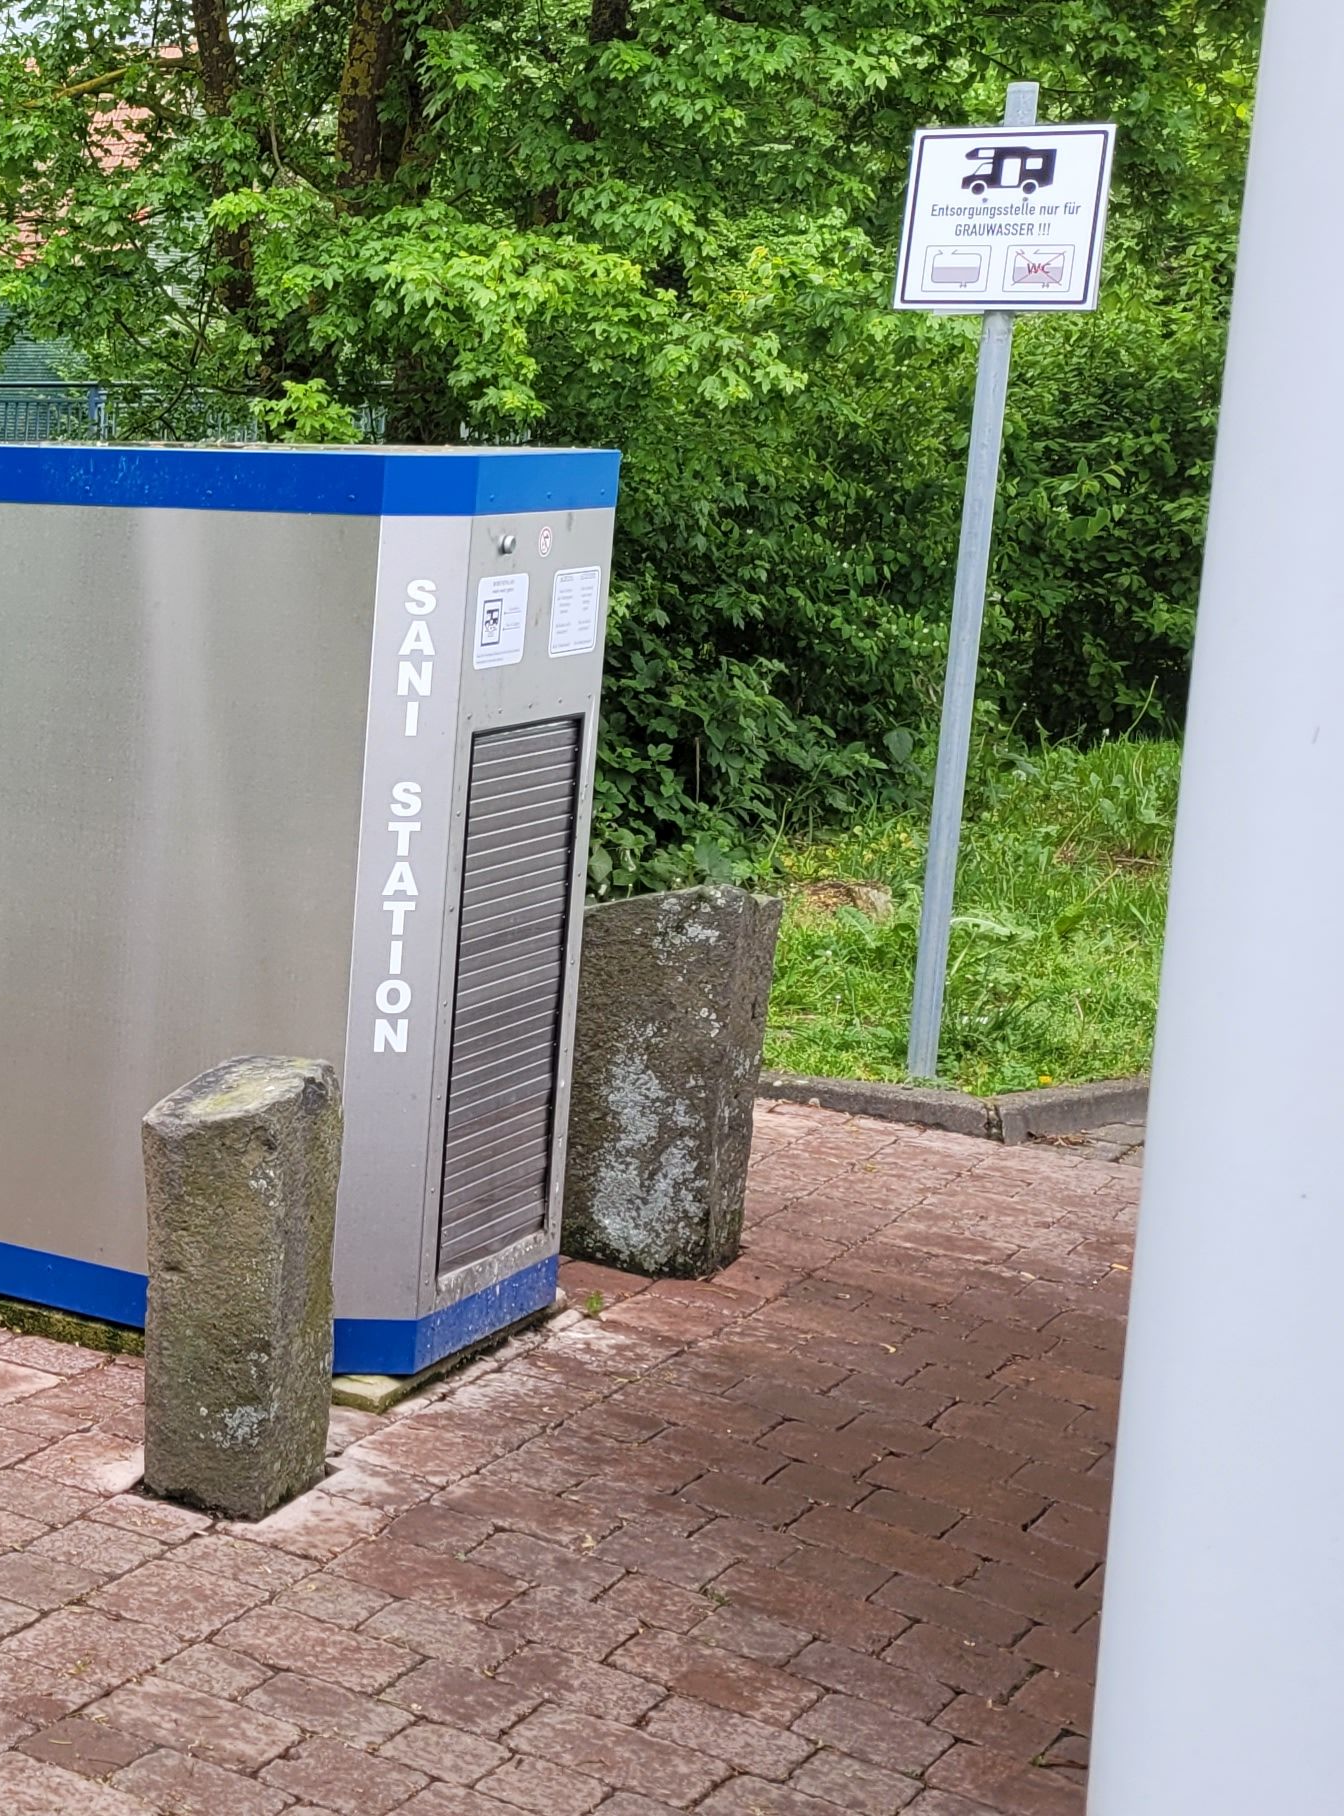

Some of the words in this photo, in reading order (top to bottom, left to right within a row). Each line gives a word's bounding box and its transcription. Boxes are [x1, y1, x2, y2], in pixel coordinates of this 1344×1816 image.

[931, 202, 1036, 219] Entsorgungsstelle
[1039, 205, 1060, 216] nur
[1063, 202, 1082, 215] für
[954, 223, 1035, 237] GRAUWASSER
[1038, 223, 1051, 236] !!!
[1027, 262, 1052, 276] WC
[396, 579, 437, 737] SANI
[373, 781, 422, 1053] STATION
